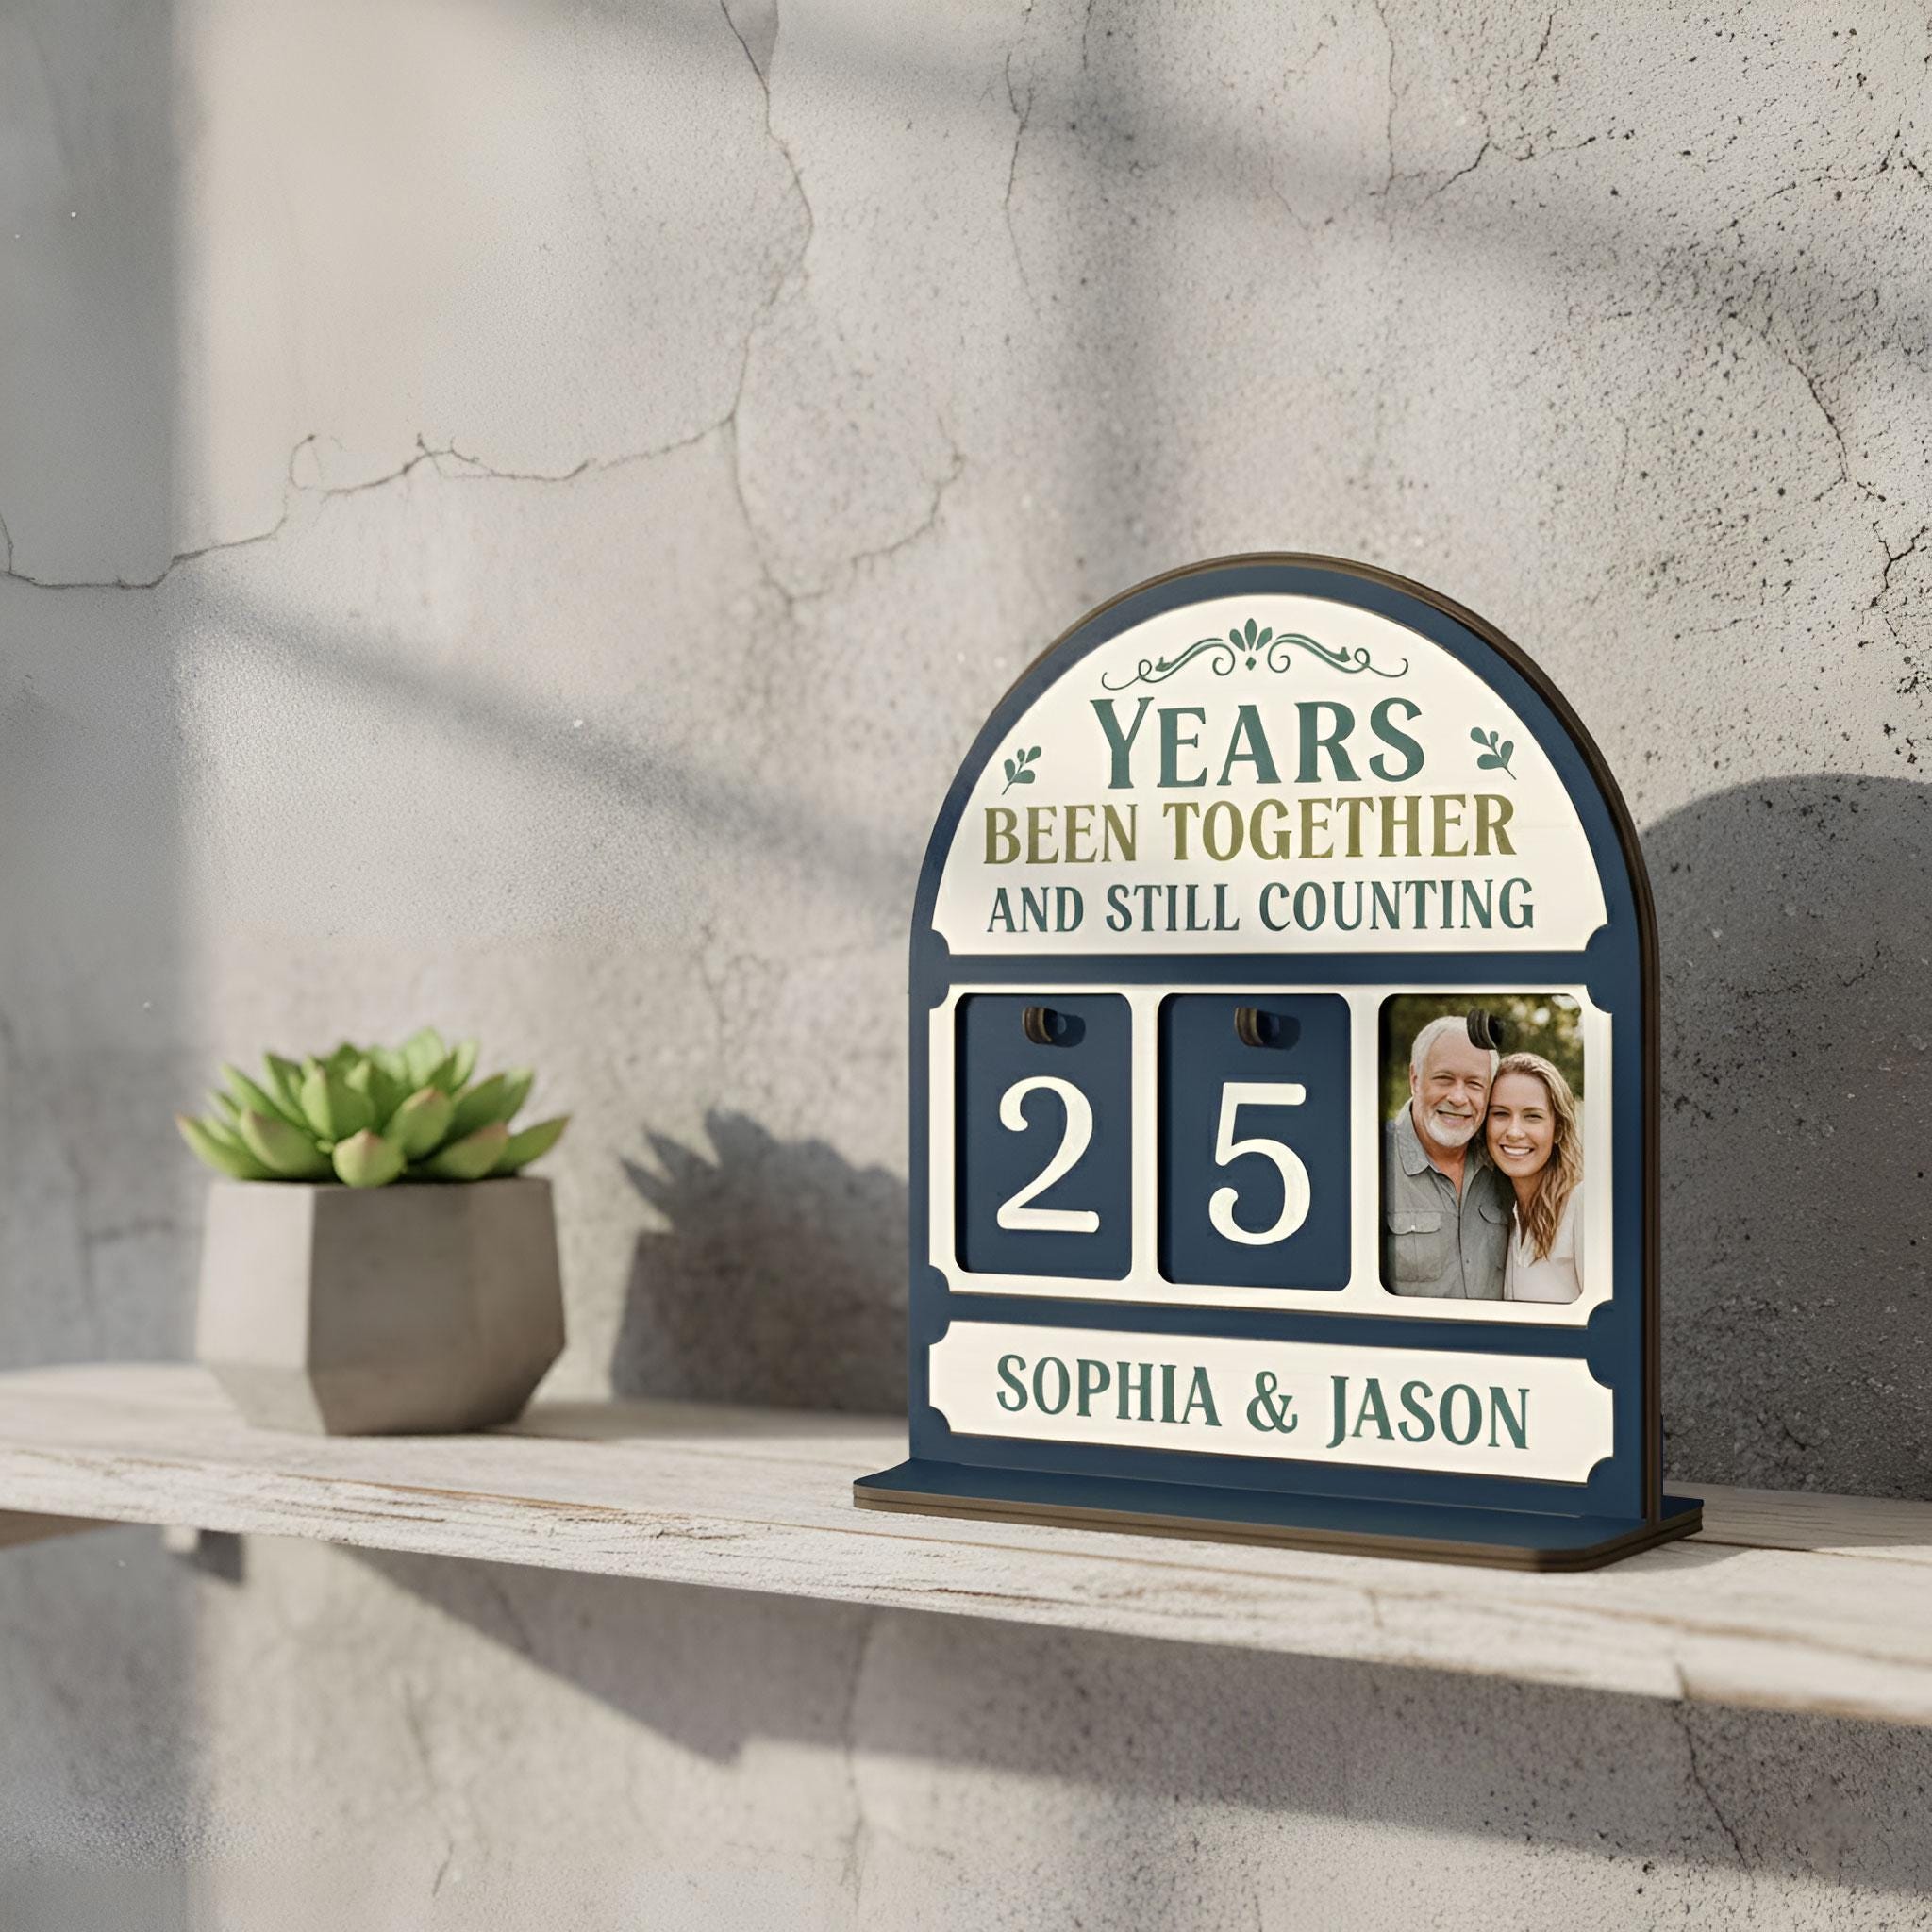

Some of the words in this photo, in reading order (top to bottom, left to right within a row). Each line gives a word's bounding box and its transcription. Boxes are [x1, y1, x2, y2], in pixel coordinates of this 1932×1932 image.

[1090, 697, 1424, 789] YEARS
[983, 804, 1138, 864] BEEN
[1163, 794, 1516, 861] TOGETHER
[987, 887, 1083, 932] AND
[1106, 884, 1240, 932] STILL
[1259, 878, 1533, 931] COUNTING
[997, 1076, 1099, 1232] 2
[1209, 1082, 1310, 1245] 5
[997, 1355, 1222, 1426] SOPHIA
[1247, 1372, 1297, 1433] &
[1326, 1376, 1530, 1449] JASON
